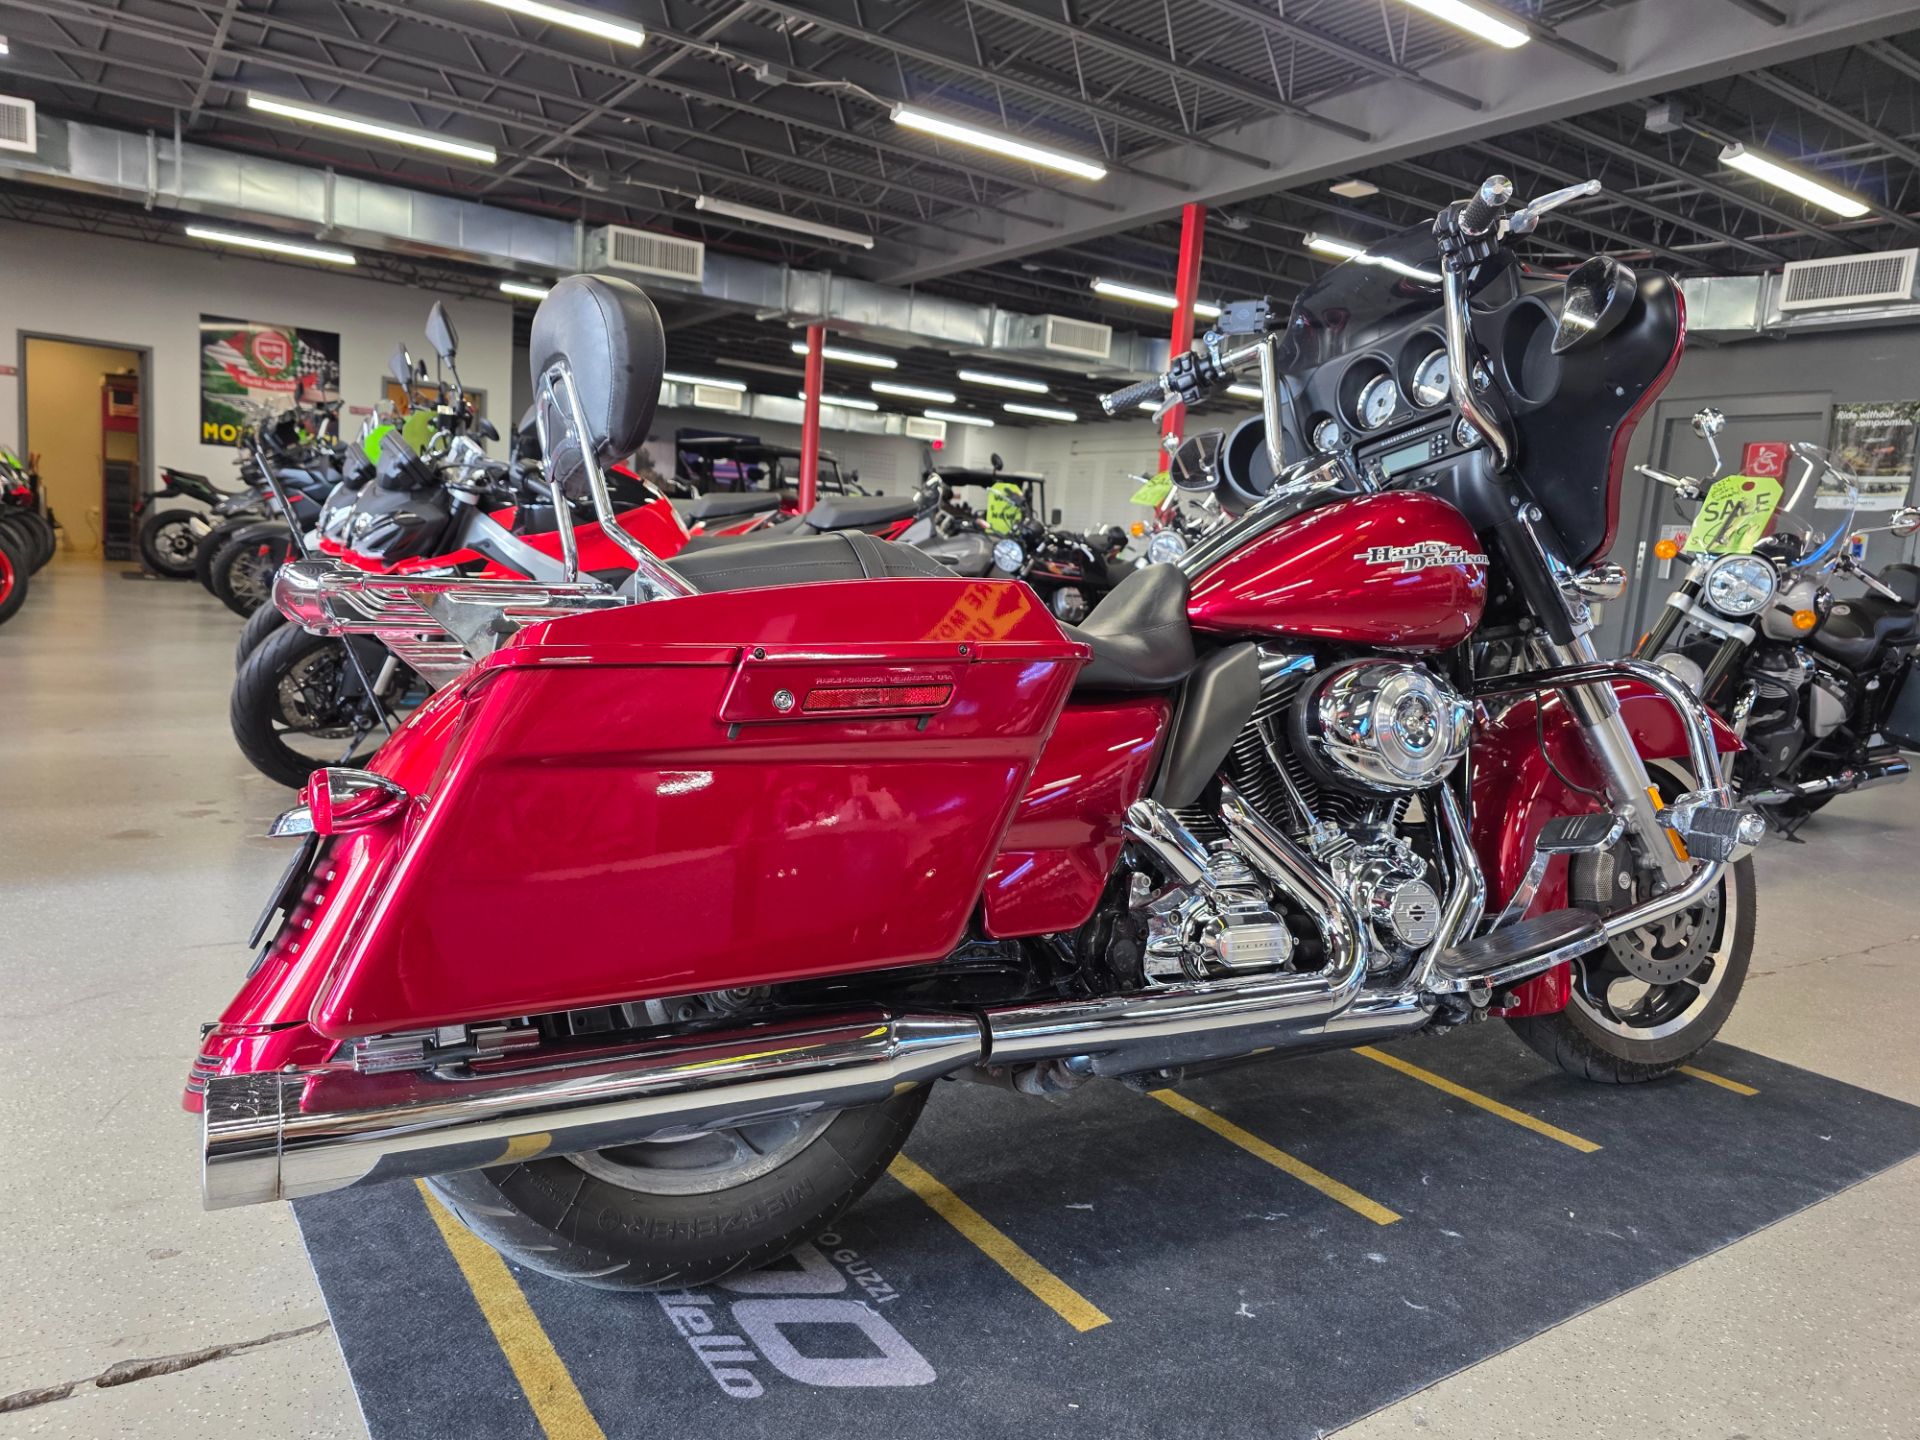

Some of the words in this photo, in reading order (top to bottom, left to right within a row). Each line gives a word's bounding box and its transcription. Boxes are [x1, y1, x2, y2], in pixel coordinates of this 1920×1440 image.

[1836, 410, 1858, 420] Ride
[1860, 409, 1895, 419] without
[1704, 492, 1771, 522] SALE
[1400, 549, 1490, 573] Davidson
[627, 1175, 814, 1240] METZELER
[833, 1248, 901, 1304] GUZZI
